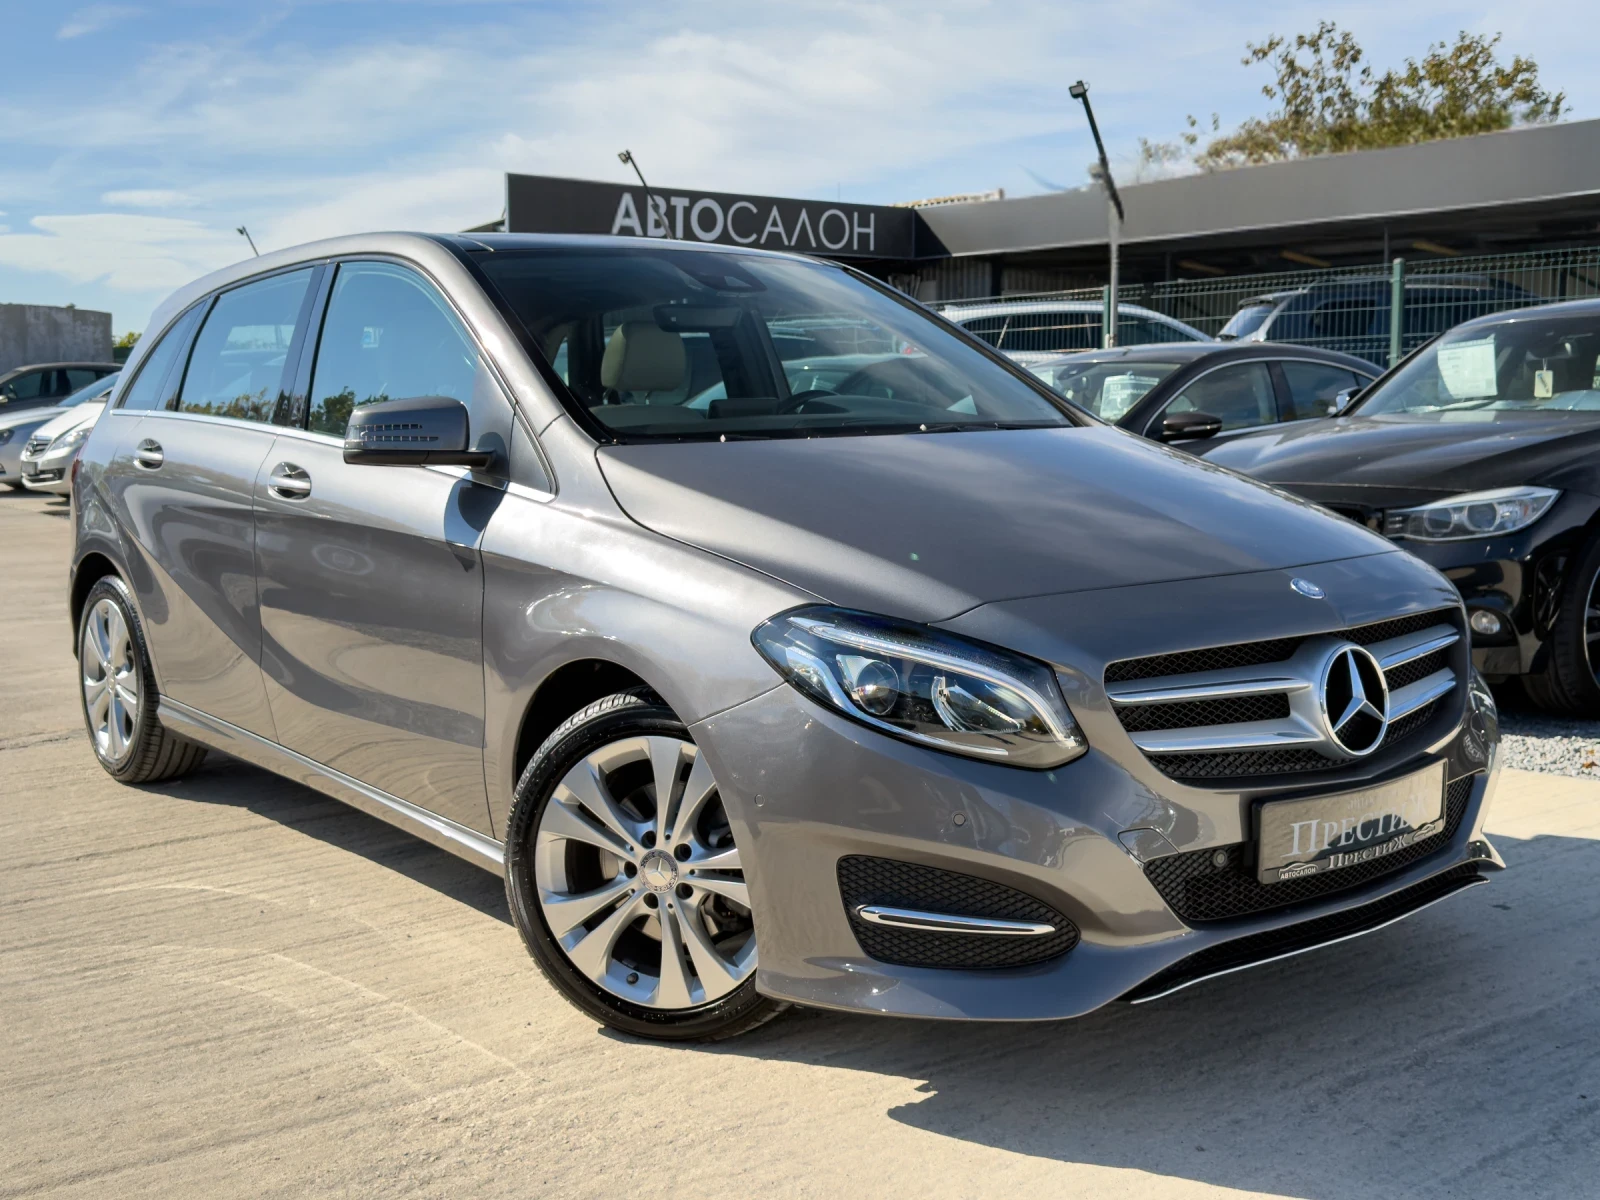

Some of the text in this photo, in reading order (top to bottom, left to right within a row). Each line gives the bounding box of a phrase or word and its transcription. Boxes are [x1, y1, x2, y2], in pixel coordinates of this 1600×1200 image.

[612, 192, 875, 251] АВТОСАЛОН
[1326, 834, 1408, 869] ПРЕСТИЖ
[1279, 866, 1317, 880] АВТОСАЛОН
